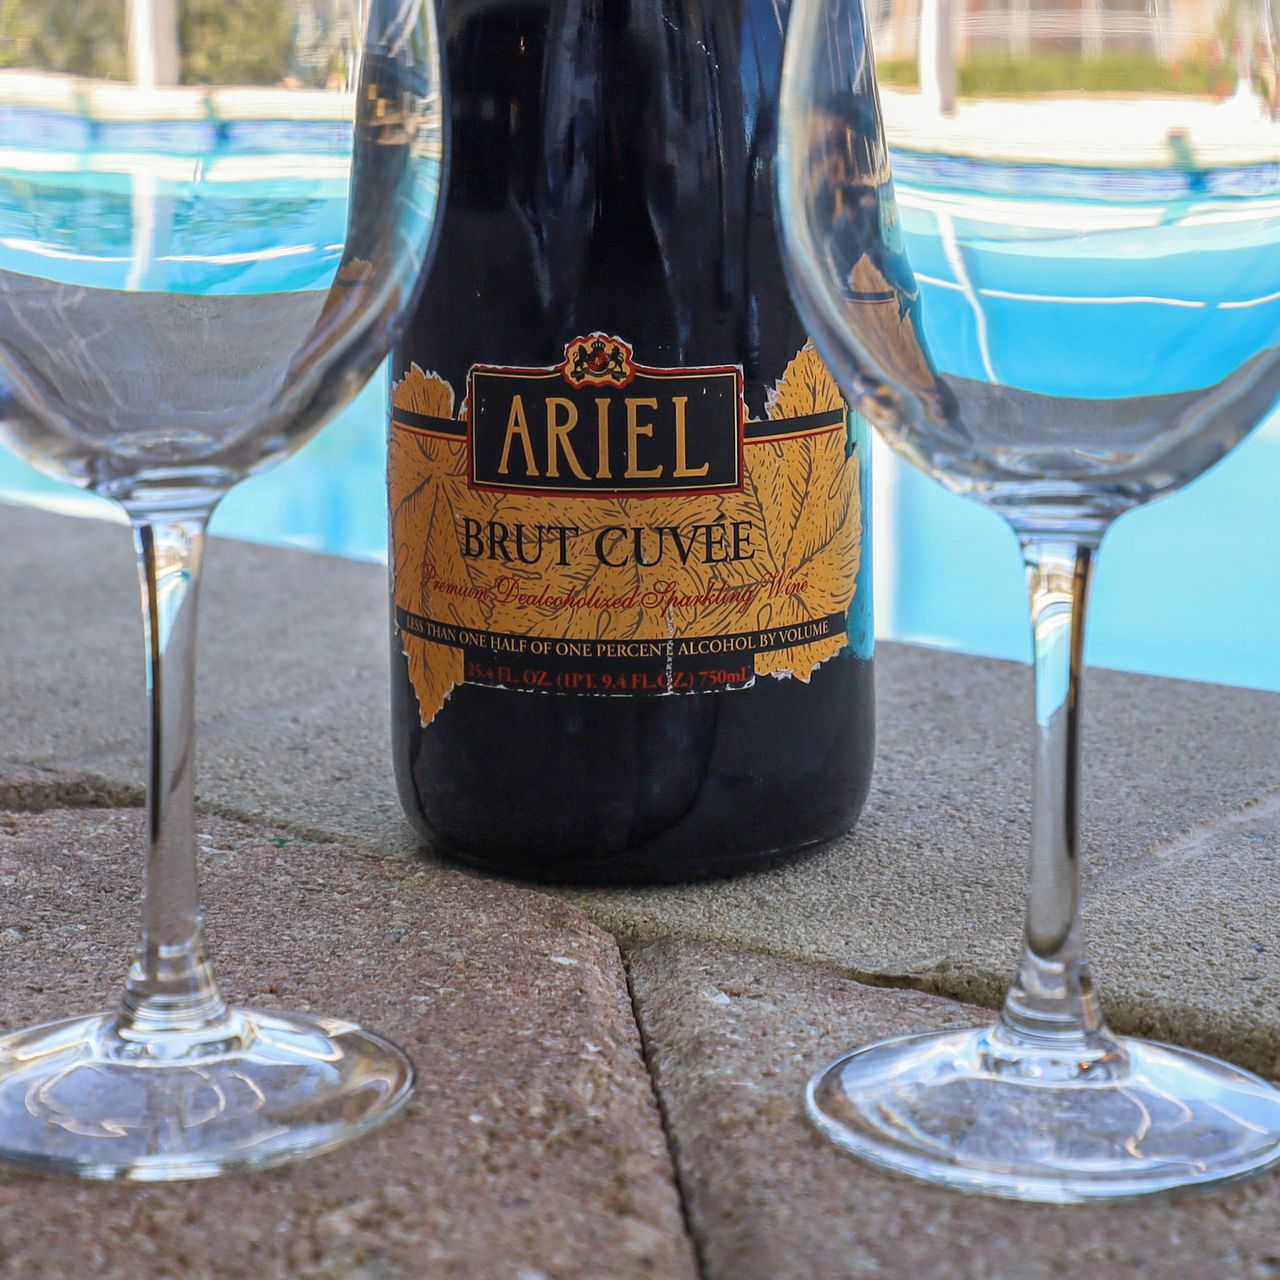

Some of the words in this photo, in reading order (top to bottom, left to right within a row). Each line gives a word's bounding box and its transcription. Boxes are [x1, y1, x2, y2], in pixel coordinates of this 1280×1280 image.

[497, 393, 710, 481] ARIEL
[463, 517, 579, 568] BRUT
[595, 513, 757, 567] CUVÉE
[421, 561, 490, 601] Premium
[493, 575, 639, 610] Dealcoholized
[641, 580, 756, 617] Sparkling
[760, 571, 809, 597] Wine
[406, 615, 424, 634] LESS
[426, 619, 457, 644] THAN
[459, 631, 487, 647] ONE
[491, 636, 527, 654] HALF
[530, 640, 552, 655] OF
[556, 643, 592, 657] ONE
[597, 643, 673, 658] PERCENT
[678, 634, 756, 657] ALCOHOL
[760, 631, 778, 647] BY
[778, 620, 829, 644] VOLUME
[497, 666, 519, 686] FL.
[603, 673, 627, 690] 9.4
